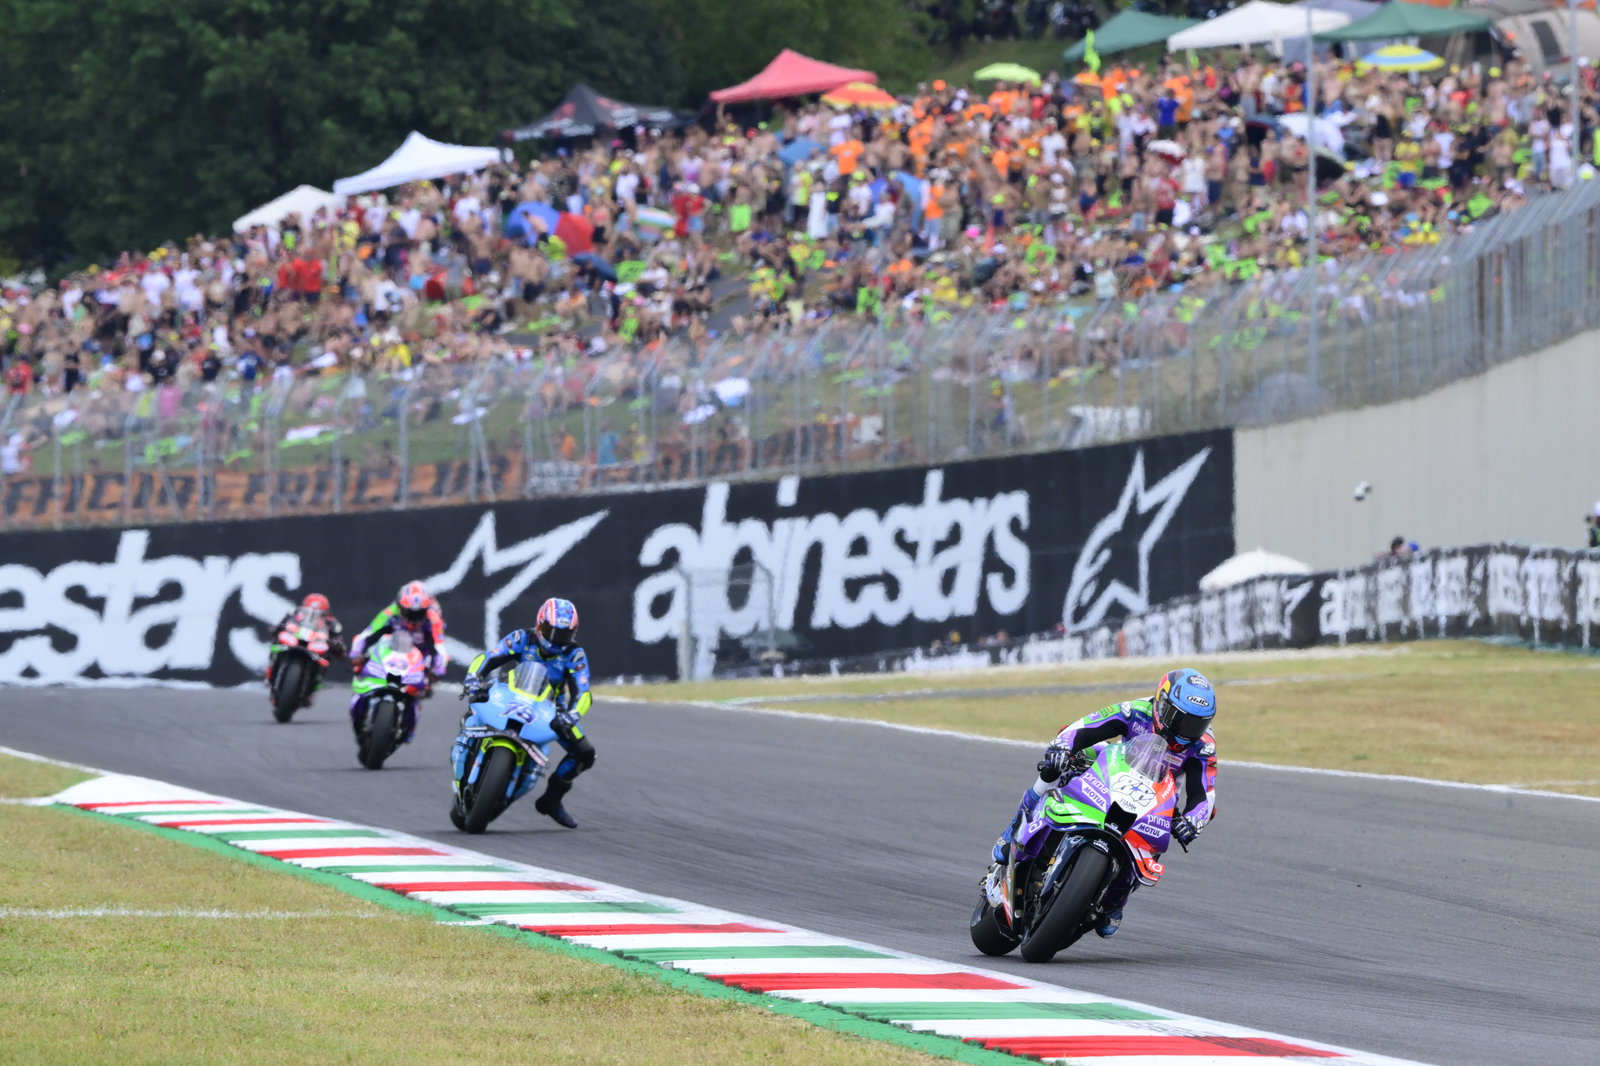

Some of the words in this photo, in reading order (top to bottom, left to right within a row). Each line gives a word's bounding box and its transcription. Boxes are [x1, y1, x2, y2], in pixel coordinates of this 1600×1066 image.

[632, 468, 1030, 681] alpinestars
[1082, 772, 1109, 794] prima
[1083, 786, 1106, 808] MOTUL
[1119, 797, 1137, 811] FIAMM
[1146, 814, 1171, 829] prima
[1138, 823, 1161, 836] MOTUL
[1147, 859, 1163, 873] 10
